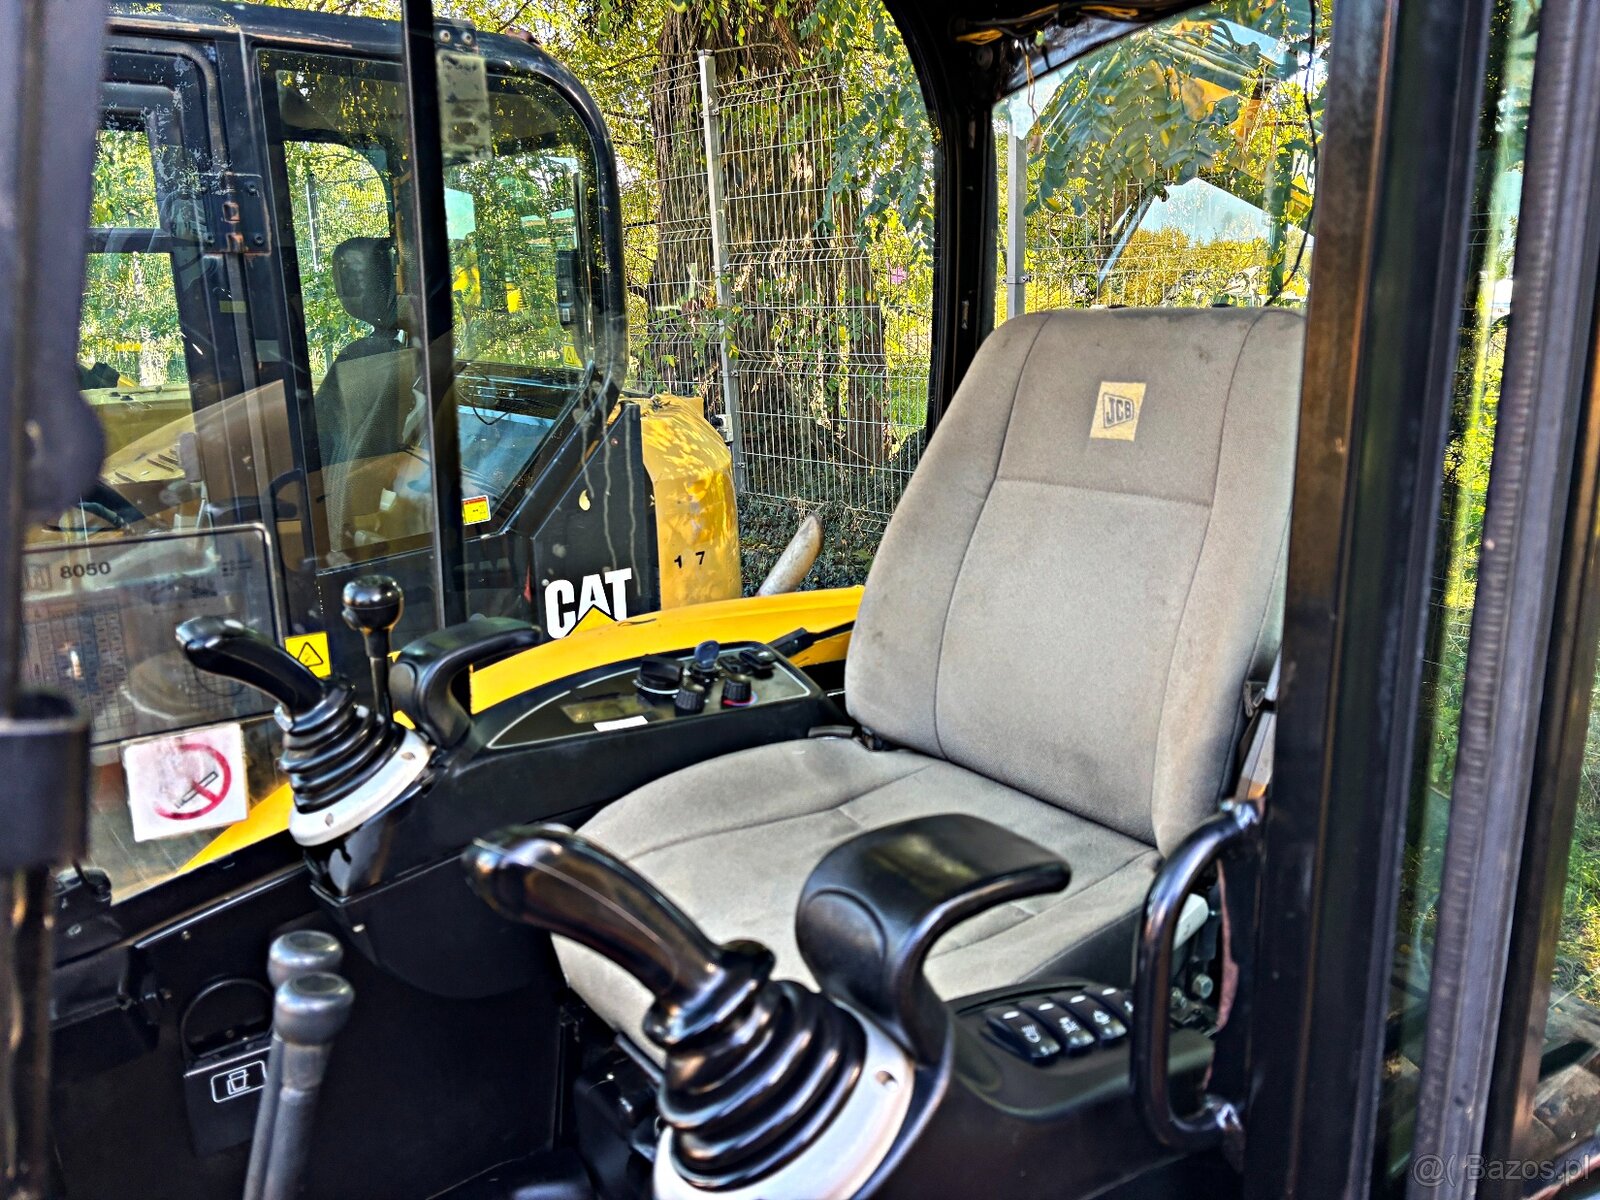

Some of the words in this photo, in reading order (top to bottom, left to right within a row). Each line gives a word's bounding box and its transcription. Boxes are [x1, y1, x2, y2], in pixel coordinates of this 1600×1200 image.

[1105, 396, 1132, 425] JCB
[60, 561, 111, 579] 8050
[544, 568, 632, 639] CAT
